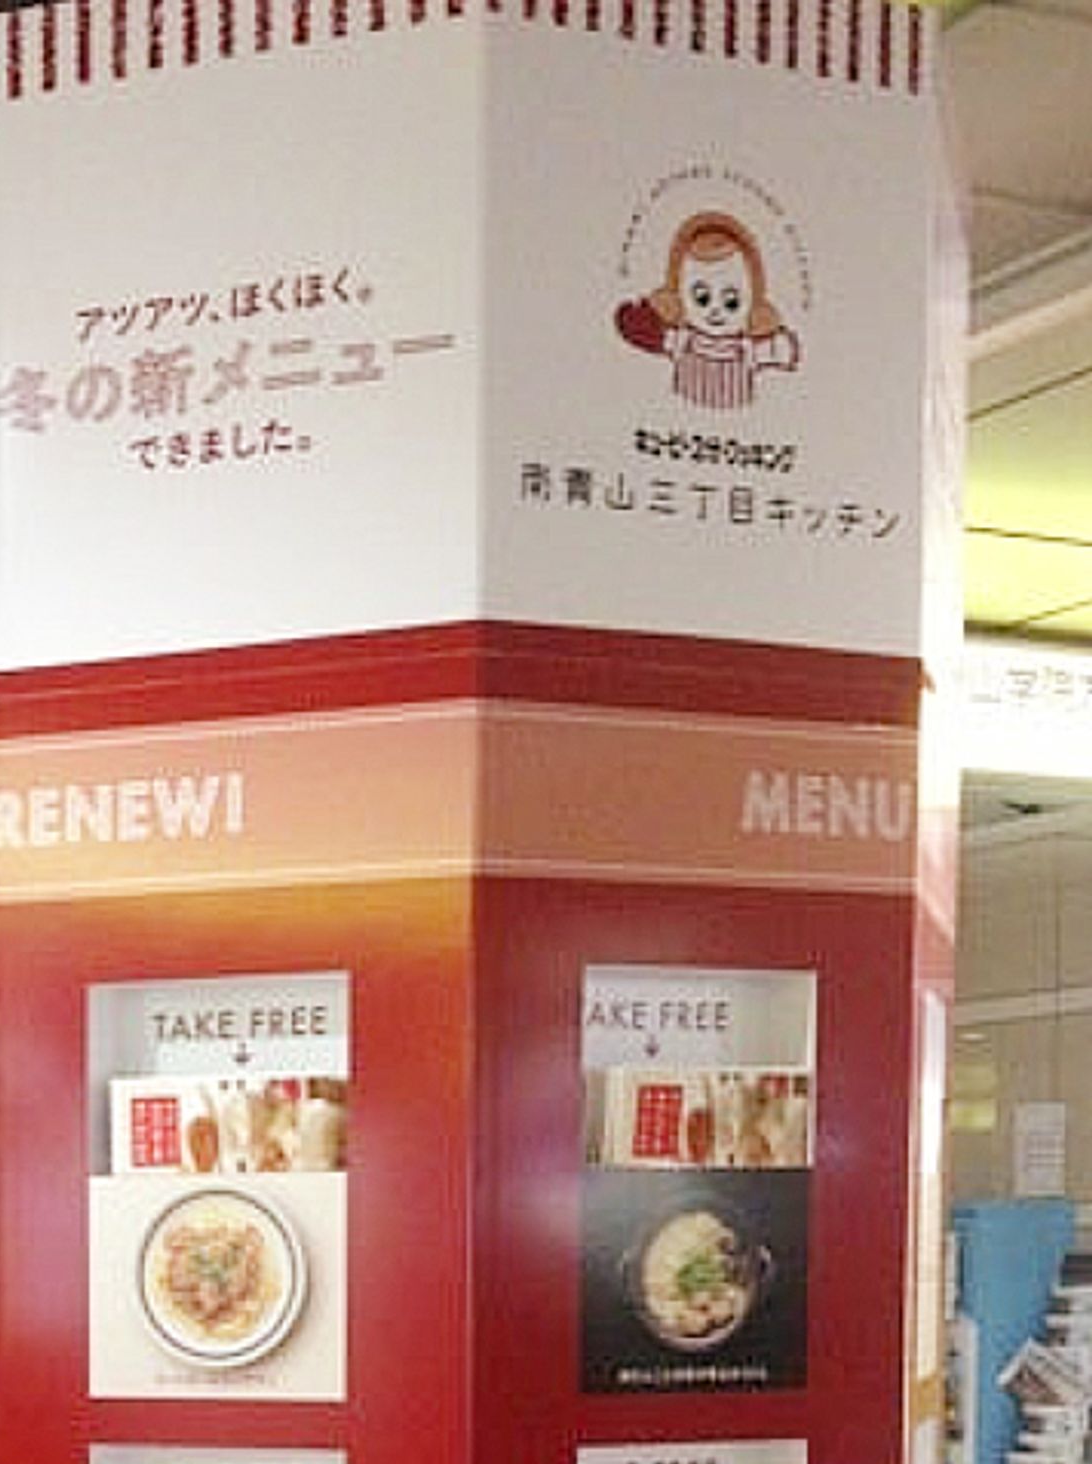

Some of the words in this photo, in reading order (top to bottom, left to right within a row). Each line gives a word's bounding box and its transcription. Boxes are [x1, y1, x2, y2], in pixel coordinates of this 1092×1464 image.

[74, 268, 375, 344] アツアツ、ほくほく。
[130, 419, 313, 470] できました。
[519, 461, 900, 538] 南青山三丁目キッチン
[741, 769, 913, 842] MENU
[153, 1009, 236, 1042] TAKE
[251, 1005, 328, 1037] FREE
[660, 1001, 732, 1031] FREE
